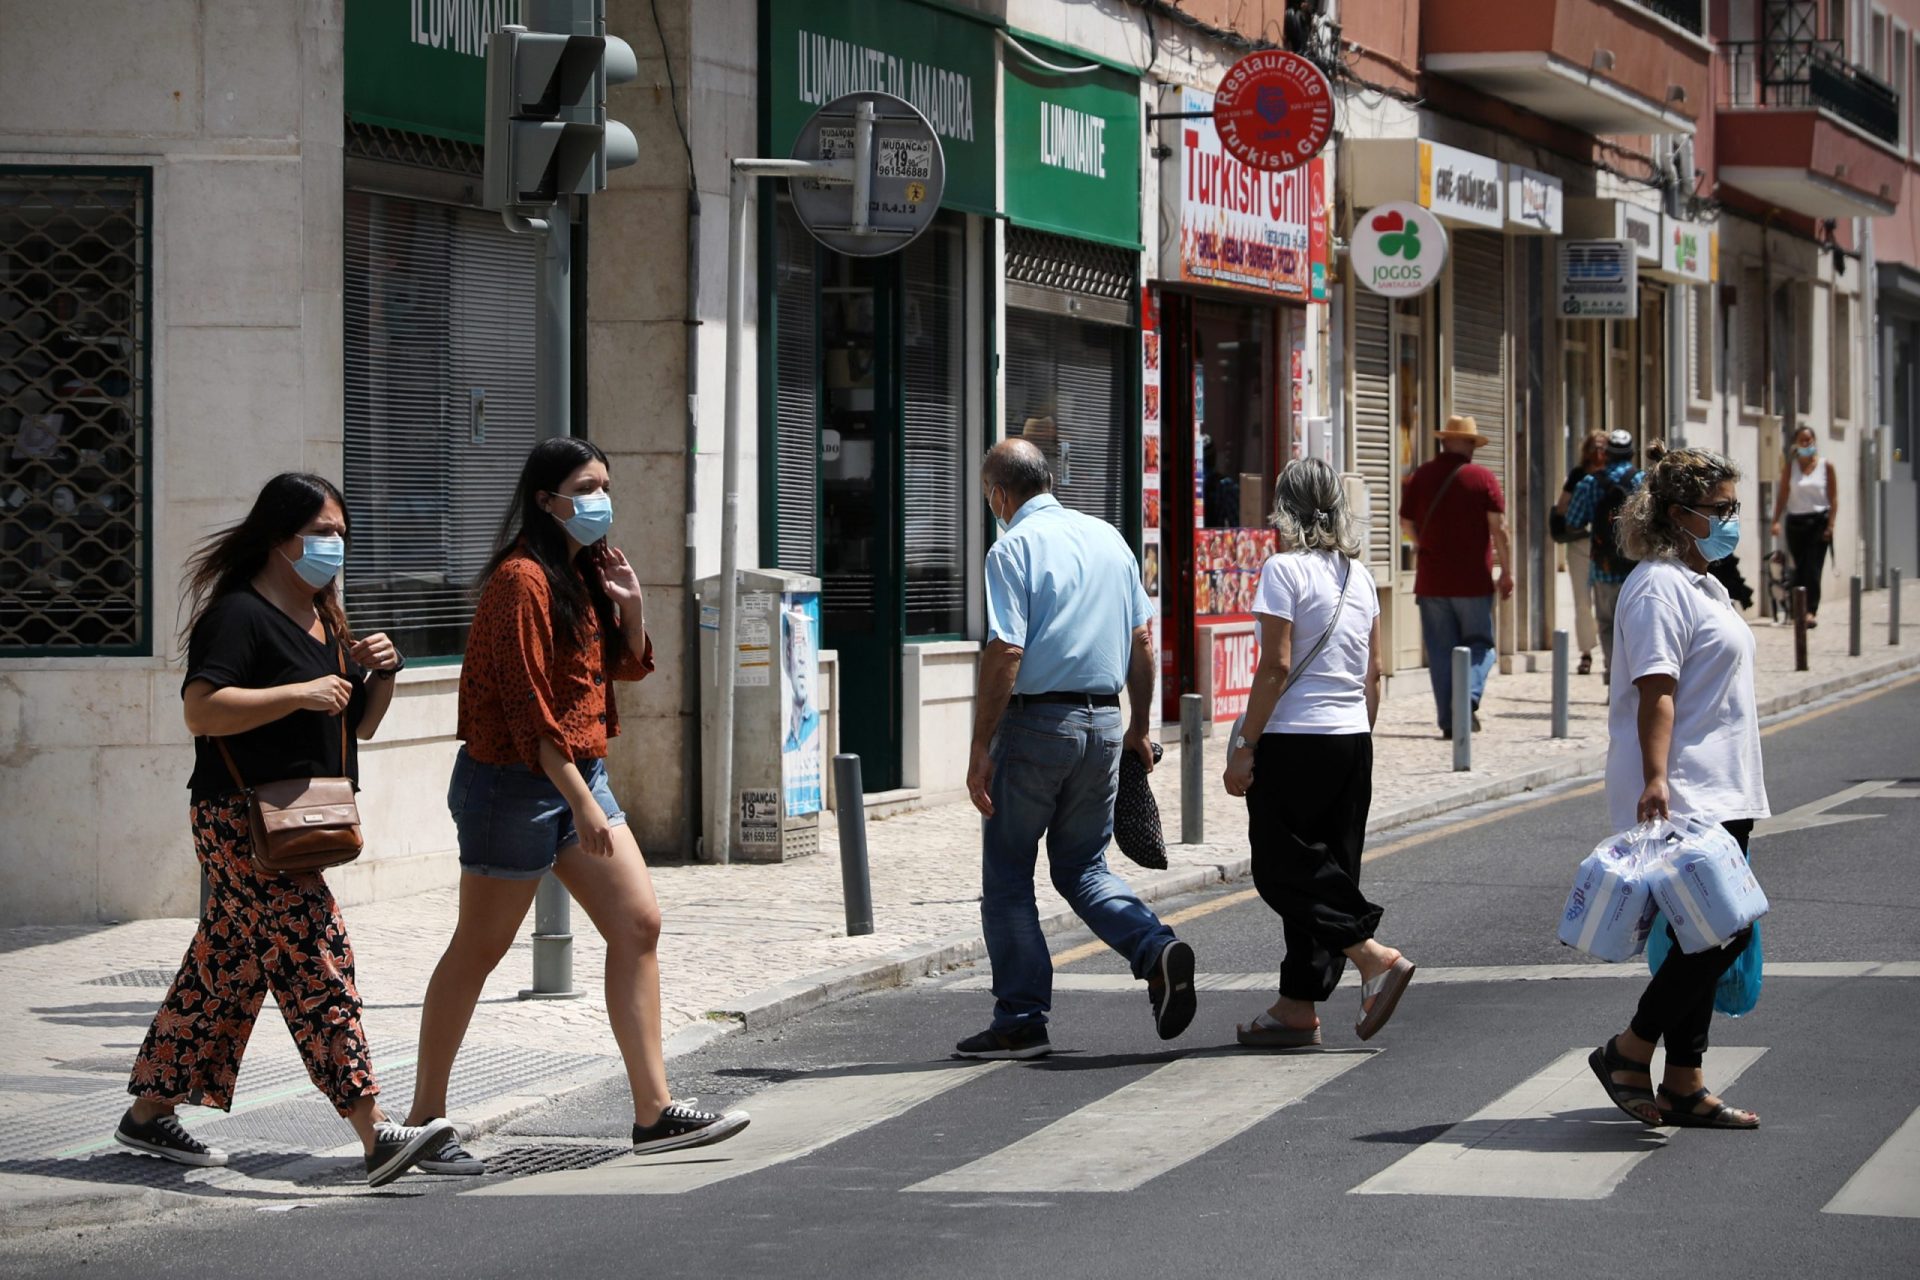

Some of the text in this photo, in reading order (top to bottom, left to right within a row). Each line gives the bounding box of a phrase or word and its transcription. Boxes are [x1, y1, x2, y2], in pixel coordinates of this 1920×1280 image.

[1216, 55, 1321, 106] Restaurante
[910, 61, 974, 143] AMADORA
[1222, 107, 1327, 167] Turkish Grill
[879, 165, 928, 177] 961546888
[894, 150, 908, 167] 19
[1185, 128, 1262, 217] Turkish
[1269, 168, 1307, 225] Grill
[1373, 265, 1422, 283] JOGOS
[1224, 634, 1256, 691] TAKE
[741, 803, 755, 819] 19
[742, 791, 777, 807] MUDANÇAS
